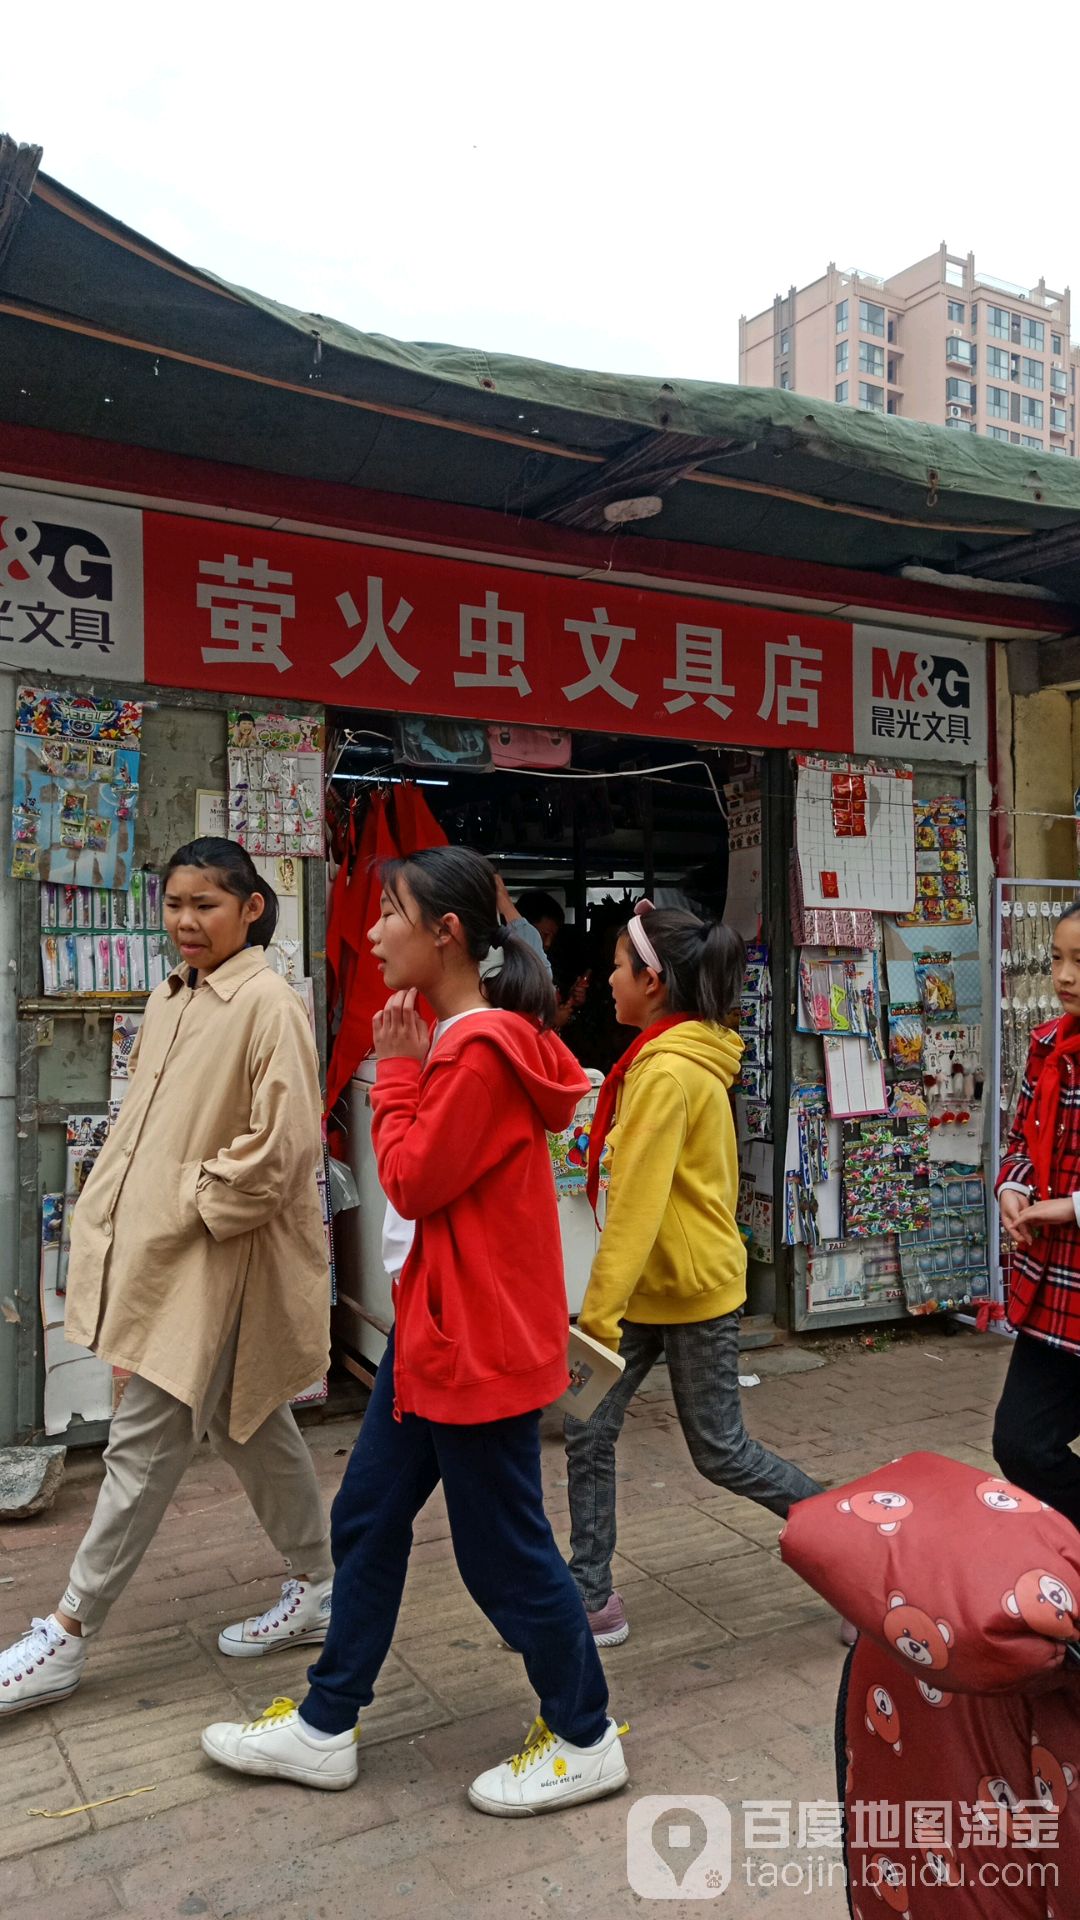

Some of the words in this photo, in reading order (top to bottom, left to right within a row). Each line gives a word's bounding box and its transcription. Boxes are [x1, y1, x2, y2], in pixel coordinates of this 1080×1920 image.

[0, 515, 113, 602] &G
[196, 554, 823, 729] 萤火虫文具店
[872, 647, 970, 709] M&G
[872, 705, 971, 746] 晨光文具
[560, 1776, 570, 1784] are
[571, 1773, 582, 1783] you
